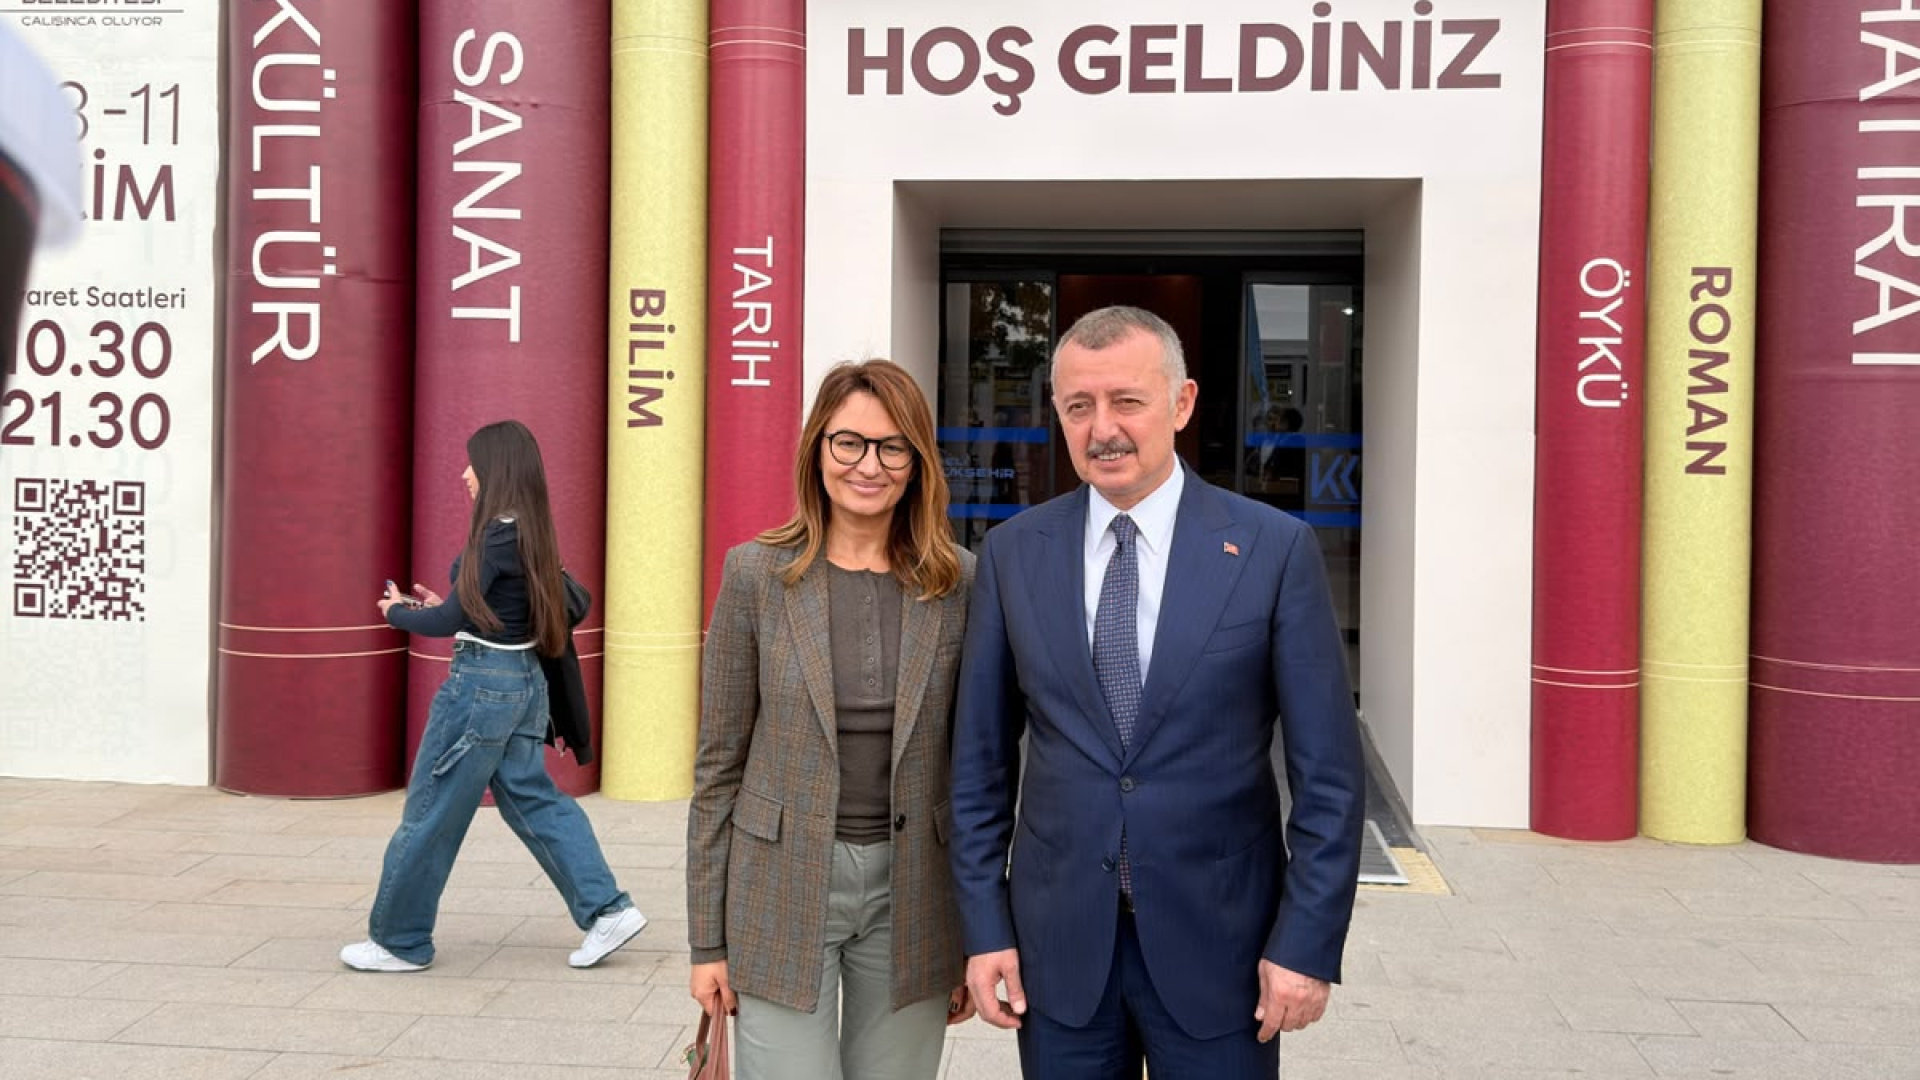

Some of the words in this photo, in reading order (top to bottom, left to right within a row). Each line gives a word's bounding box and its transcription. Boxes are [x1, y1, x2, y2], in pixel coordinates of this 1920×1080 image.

[101, 16, 163, 27] OLUYOR
[847, 25, 1036, 117] HOŞ
[1057, 0, 1502, 95] GELDİNİZ
[80, 148, 176, 222] İM
[252, 0, 337, 364] KÜLTÜR
[452, 28, 524, 342] SANAT
[26, 288, 79, 307] aret
[86, 285, 186, 309] Saatleri
[627, 288, 676, 429] BİLİM
[731, 236, 780, 387] TARİH
[1576, 257, 1632, 408] ÖYKÜ
[1, 389, 171, 451] 21.30
[1684, 266, 1733, 476] ROMAN
